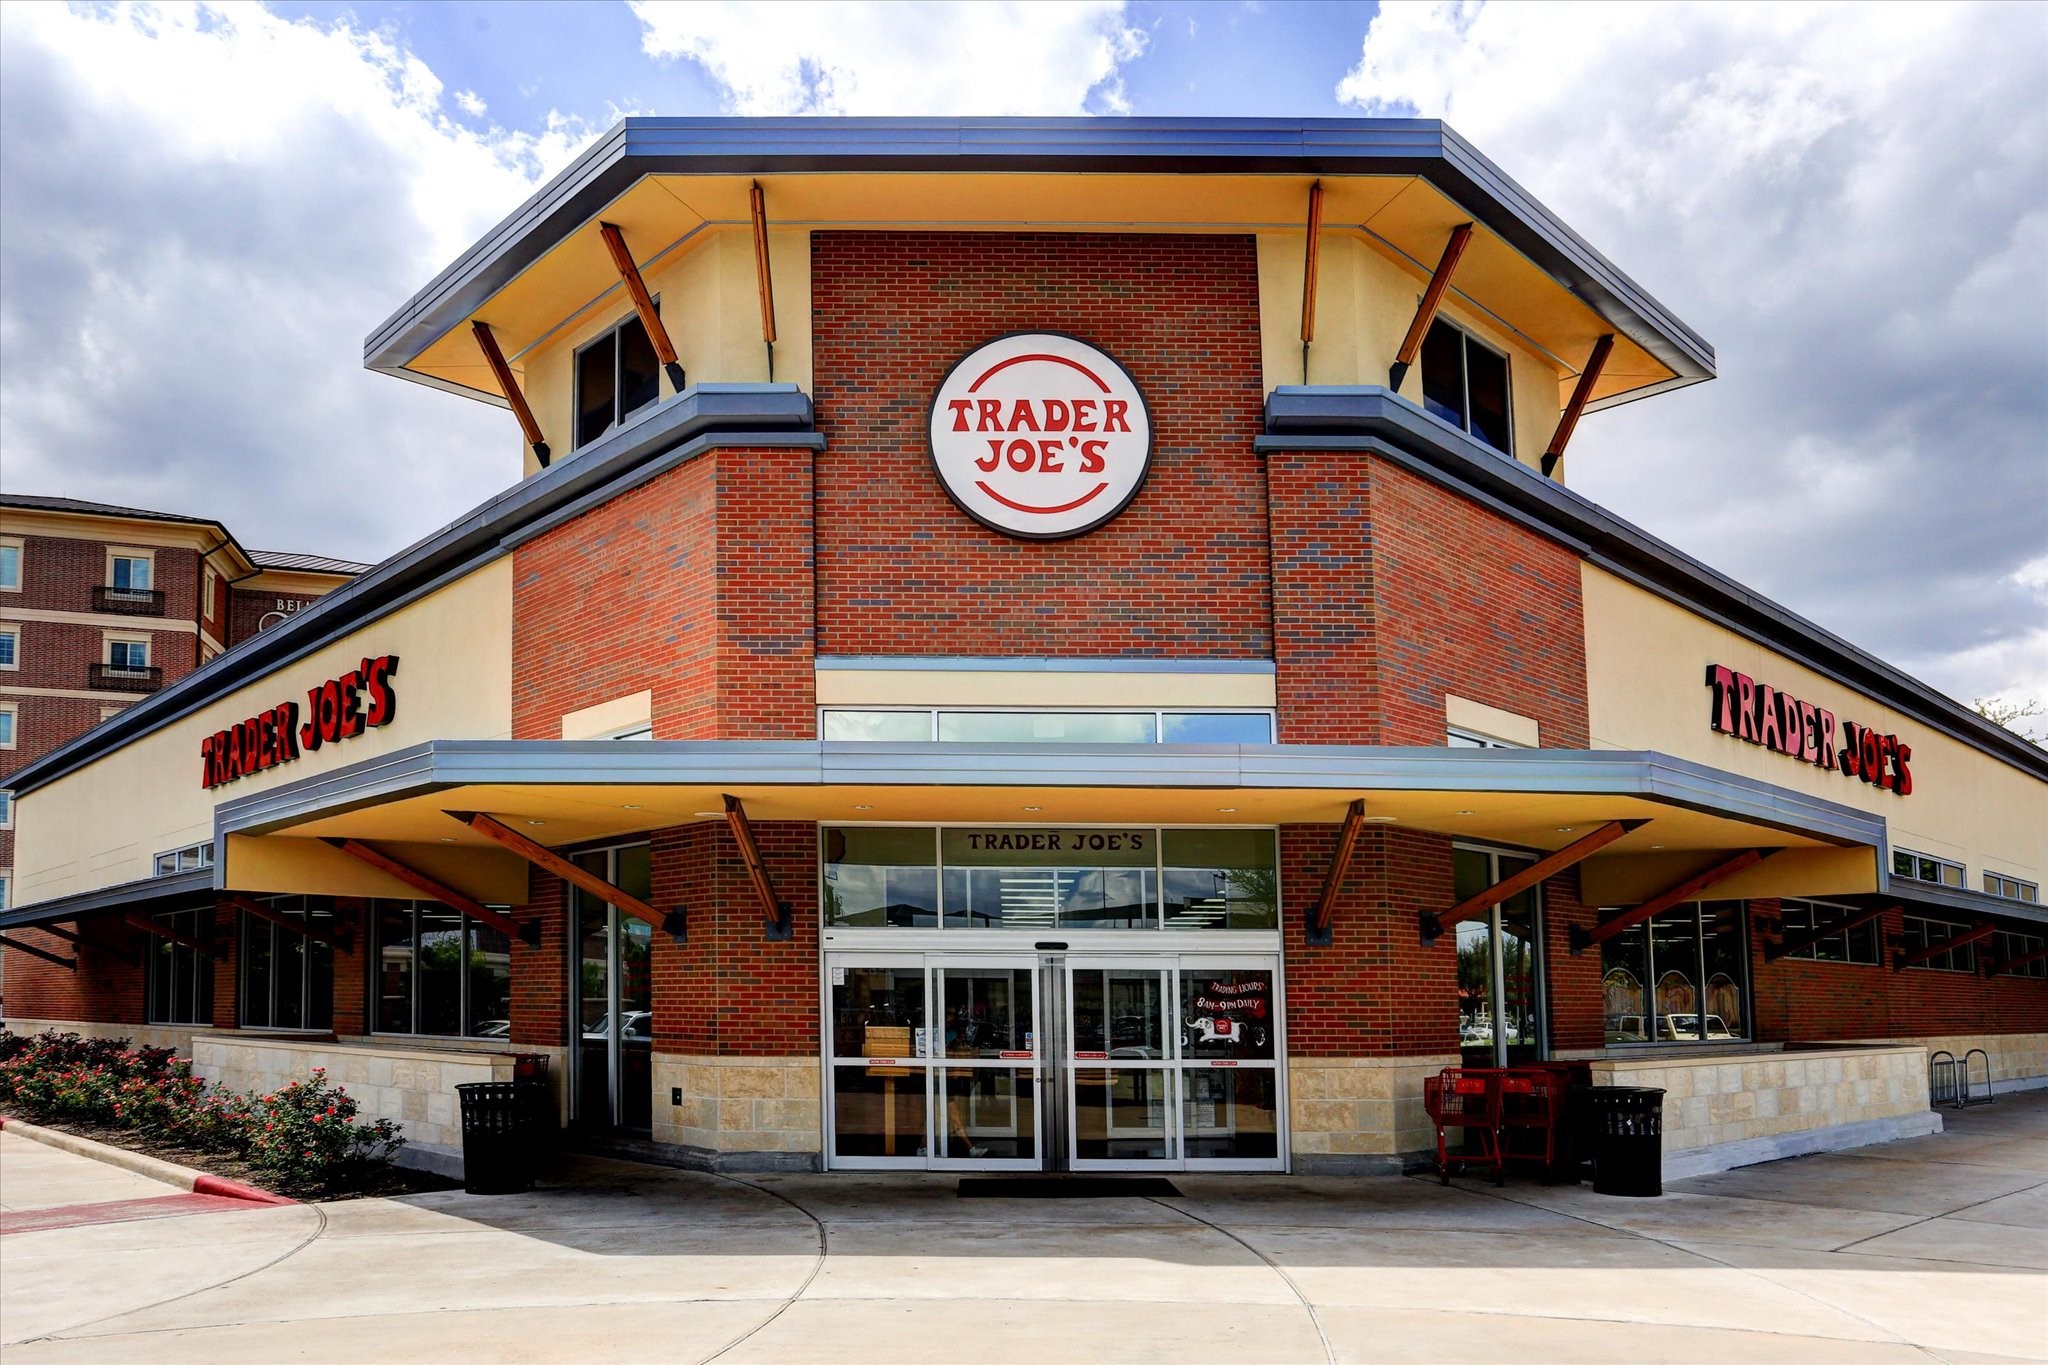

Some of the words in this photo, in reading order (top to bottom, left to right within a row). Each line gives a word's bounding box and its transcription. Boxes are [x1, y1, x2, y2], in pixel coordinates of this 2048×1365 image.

[948, 399, 1132, 432] TRADER
[974, 436, 1109, 473] JOE'S
[201, 701, 300, 789] TRADER
[299, 655, 400, 751] JOE'S
[1705, 663, 1840, 771] TRADER
[1837, 721, 1912, 796] JOE'S
[967, 834, 1062, 850] TRADER
[1071, 832, 1143, 851] JOE'S
[1210, 981, 1238, 994] TRADING
[1238, 982, 1265, 994] HOURS
[1236, 999, 1261, 1010] DAILY
